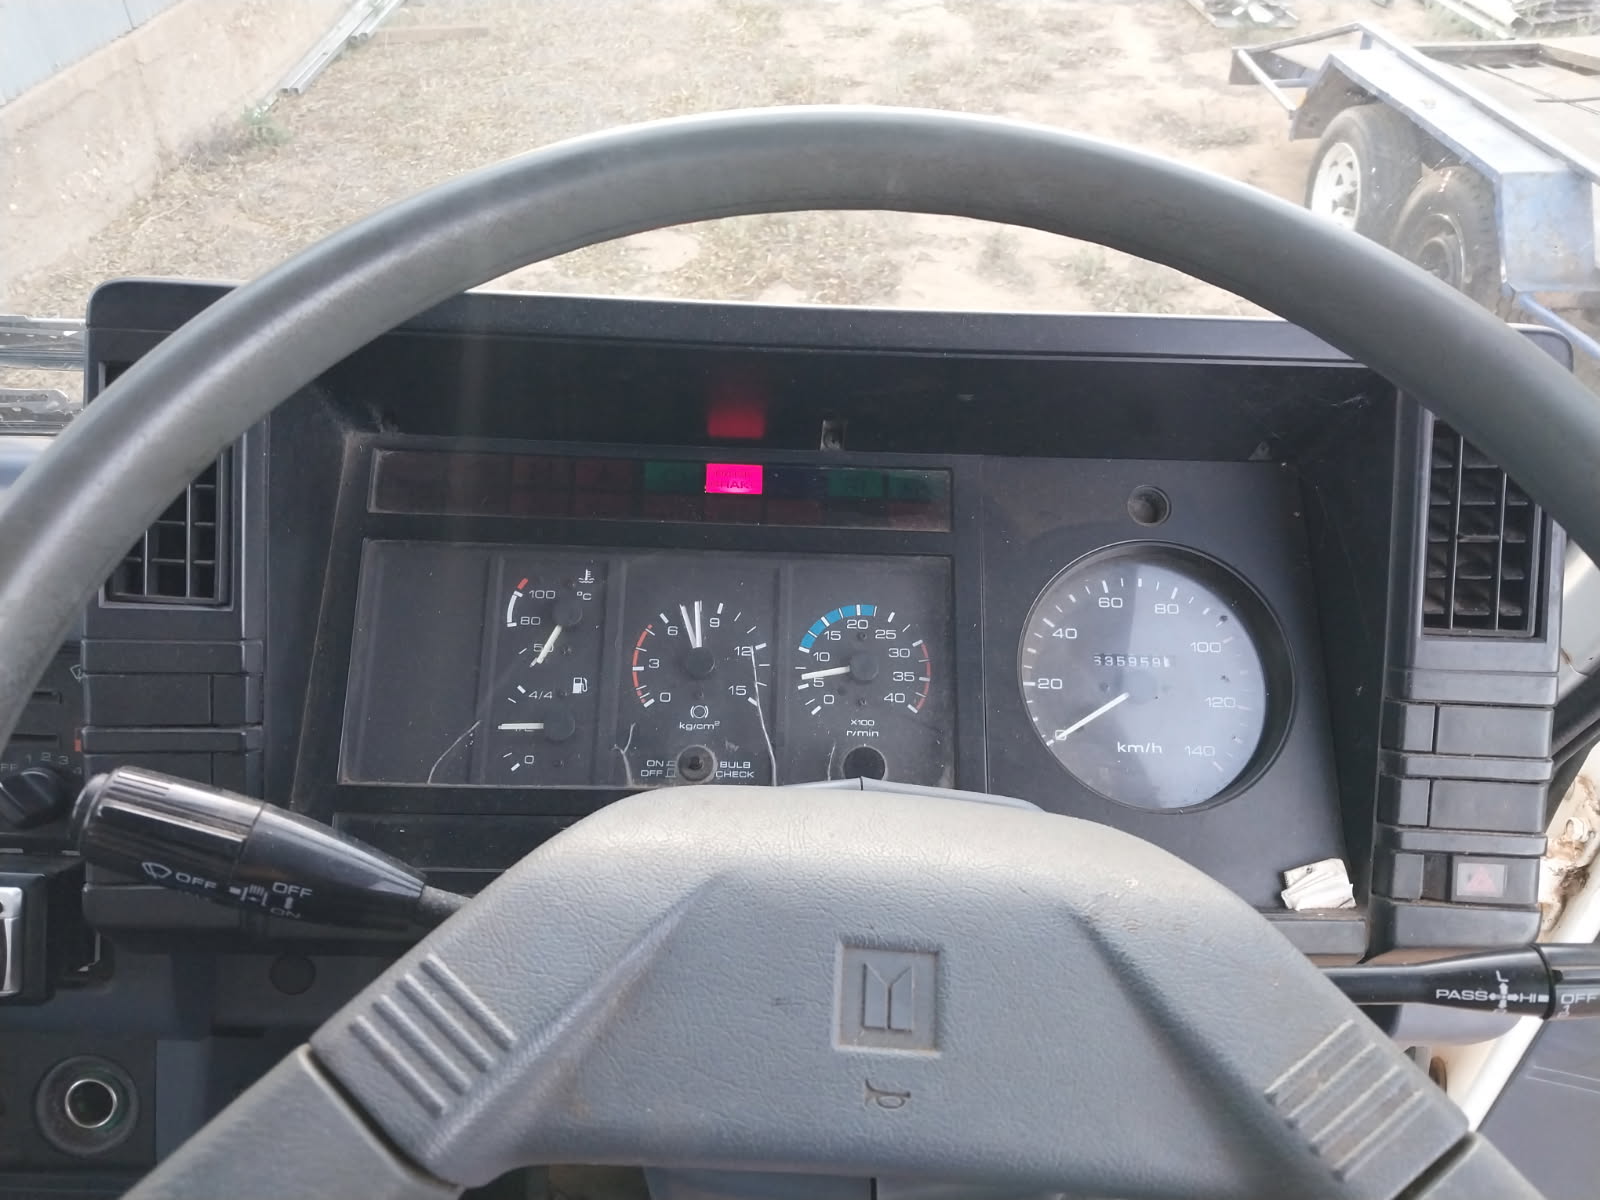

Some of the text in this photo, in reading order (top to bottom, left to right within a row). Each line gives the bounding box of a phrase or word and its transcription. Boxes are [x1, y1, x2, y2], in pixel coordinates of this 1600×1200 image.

[528, 590, 556, 600] 100
[1098, 597, 1123, 608] 60
[1154, 604, 1179, 614] 80
[520, 616, 541, 626] 80
[709, 618, 720, 628] 9
[846, 619, 869, 629] 20
[667, 626, 678, 636] 6
[823, 630, 841, 641] 15
[875, 630, 897, 640] 25
[1052, 628, 1077, 639] 40
[734, 646, 752, 657] 12
[1190, 642, 1221, 653] 100
[813, 652, 830, 662] 10
[888, 648, 910, 658] 30
[649, 659, 660, 669] 3
[892, 671, 915, 682] 35
[813, 678, 824, 688] 5
[1037, 679, 1062, 690] 20
[528, 690, 553, 700] 4/4
[728, 686, 747, 695] 15
[660, 693, 671, 702] 0
[823, 695, 834, 705] 0
[883, 693, 905, 703] 40
[1204, 697, 1236, 708] 120
[1117, 741, 1162, 753] km/h
[1184, 746, 1215, 757] 140
[58, 756, 69, 765] 3
[524, 755, 534, 764] 0
[719, 761, 751, 769] BULB
[640, 769, 663, 777] OFF
[715, 770, 754, 778] CHECK
[175, 872, 217, 890] OFF
[272, 881, 313, 898] OFF
[1436, 989, 1537, 1003] PASS HI
[1561, 992, 1597, 1004] OFF
